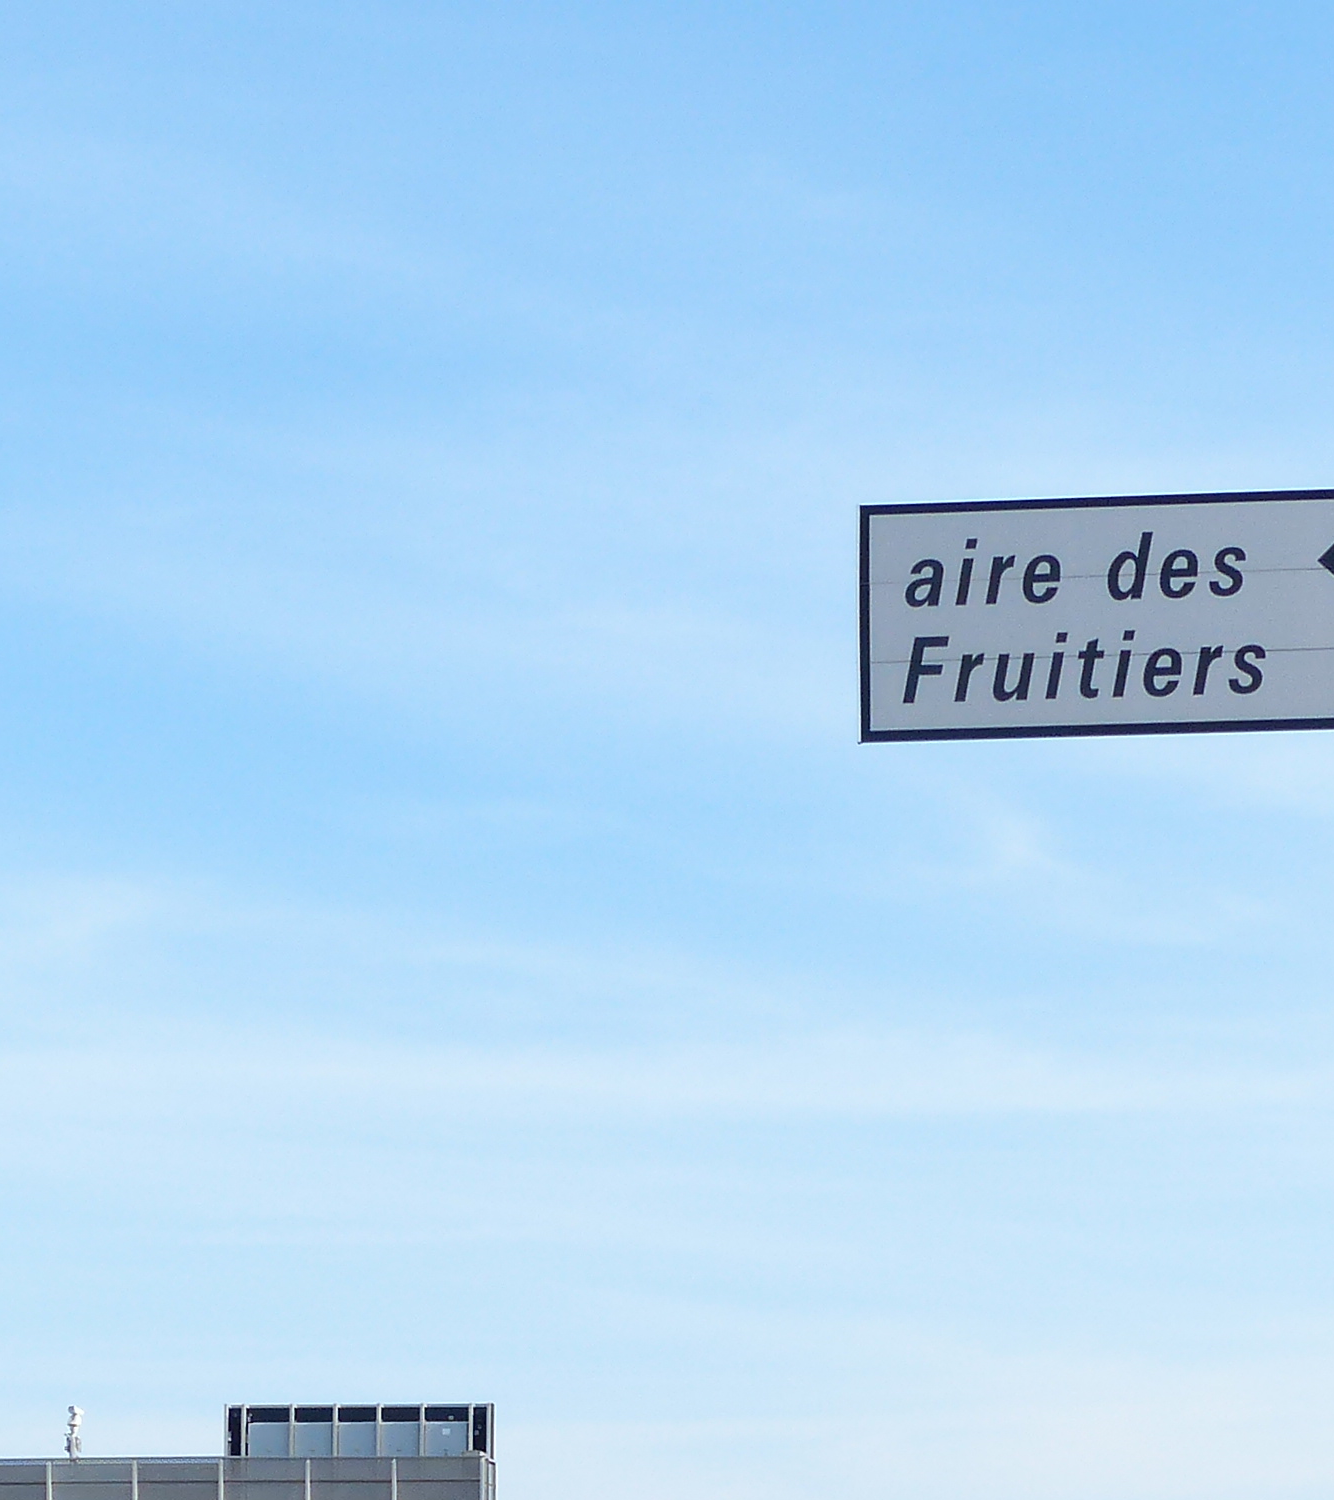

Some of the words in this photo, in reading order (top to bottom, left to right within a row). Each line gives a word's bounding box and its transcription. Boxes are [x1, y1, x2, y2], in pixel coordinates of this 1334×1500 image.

[904, 538, 1062, 608] aire
[1107, 531, 1248, 601] des
[902, 629, 1267, 704] Fruitiers
